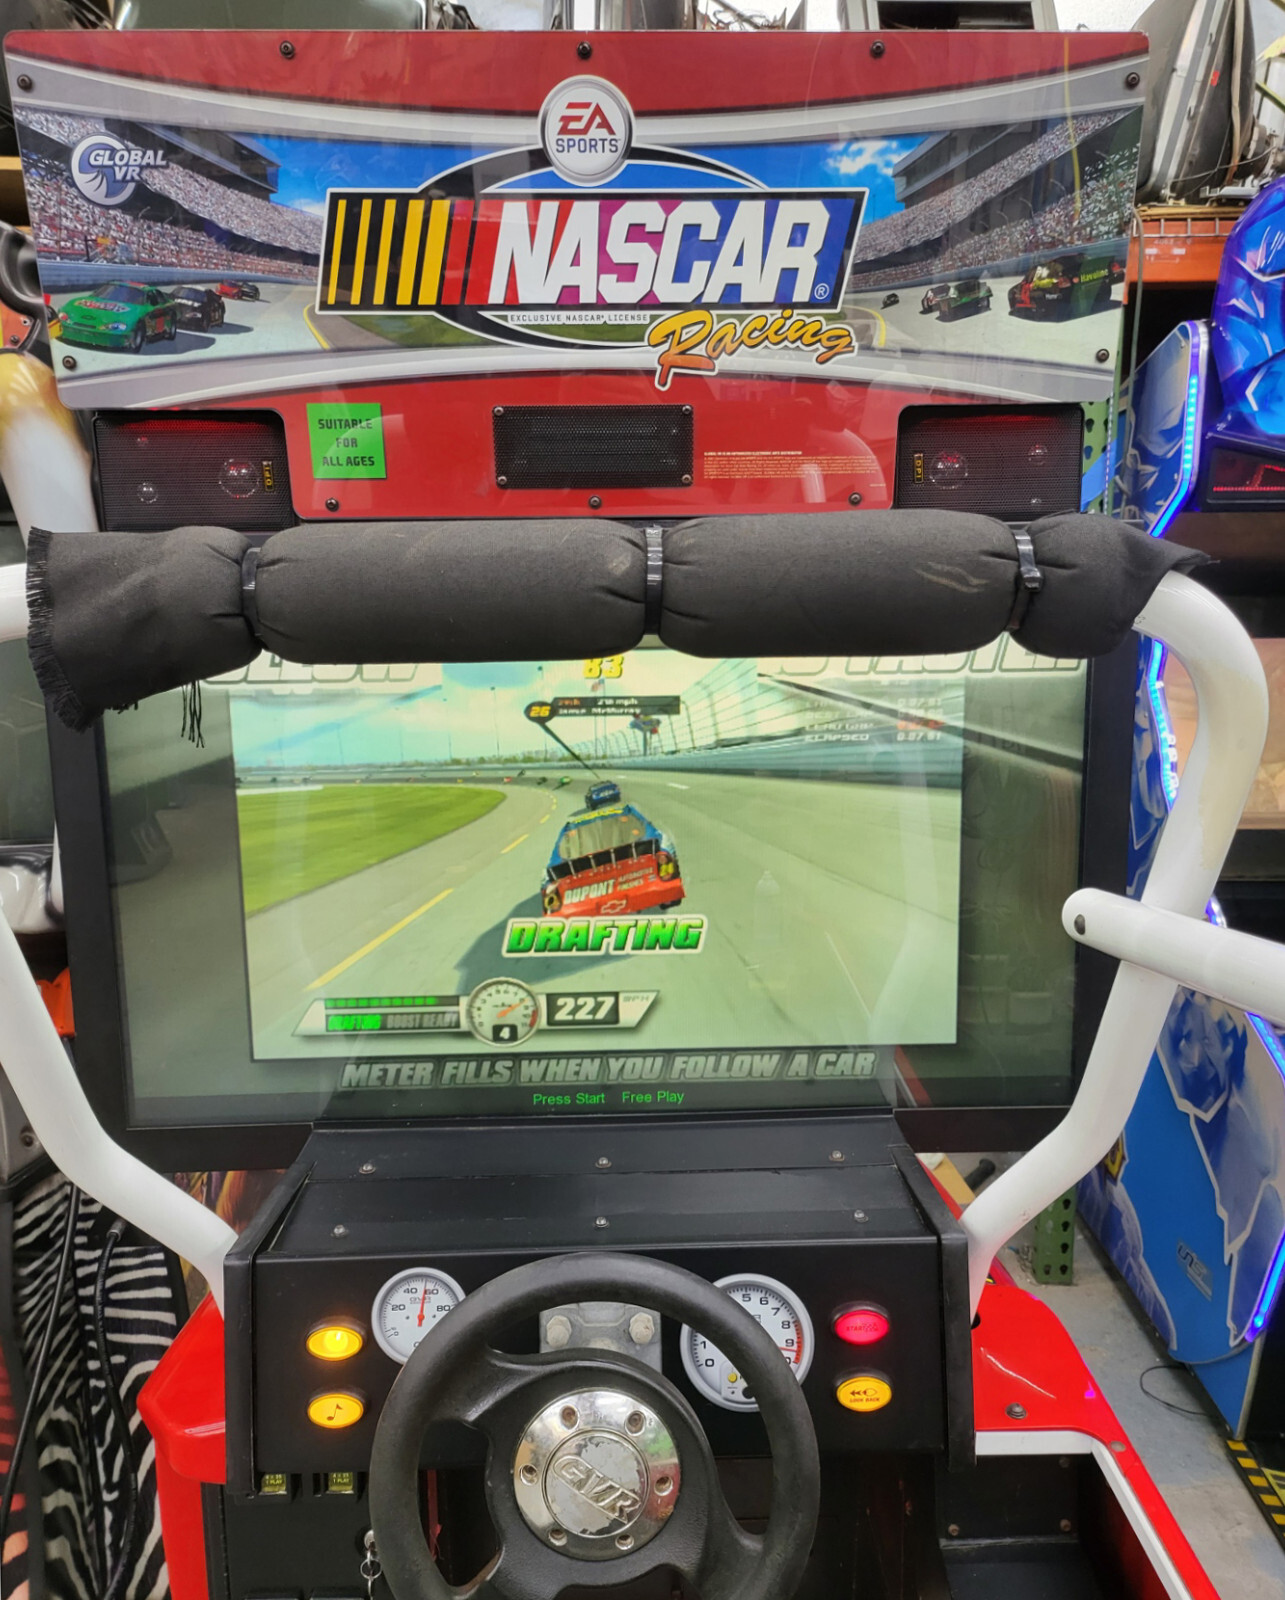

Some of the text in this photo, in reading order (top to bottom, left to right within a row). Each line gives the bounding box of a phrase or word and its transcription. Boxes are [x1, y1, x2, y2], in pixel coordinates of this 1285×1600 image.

[557, 102, 616, 135] EA
[556, 138, 619, 154] SPORTS
[89, 149, 167, 166] GLOBAL
[114, 166, 141, 181] VR
[510, 314, 562, 322] EXCLUSIVE
[647, 309, 855, 387] Racing
[318, 418, 373, 430] SUITABLE
[336, 437, 358, 448] FOR
[323, 456, 375, 467] ALL AGES
[529, 706, 552, 718] 26
[504, 917, 704, 953] DRAFTING
[554, 996, 615, 1021] 227
[499, 1026, 511, 1040] 4
[341, 1052, 876, 1088] METER FILLS WHEN YOU FOLLOW A CAR
[533, 1090, 685, 1105] Press Start Free Play
[742, 1293, 751, 1302] 5
[760, 1297, 769, 1305] 6
[436, 1304, 451, 1312] 80
[771, 1307, 780, 1316] 7
[781, 1320, 791, 1329] 8
[700, 1340, 707, 1349] 1
[785, 1338, 794, 1347] 9
[705, 1358, 715, 1367] 0
